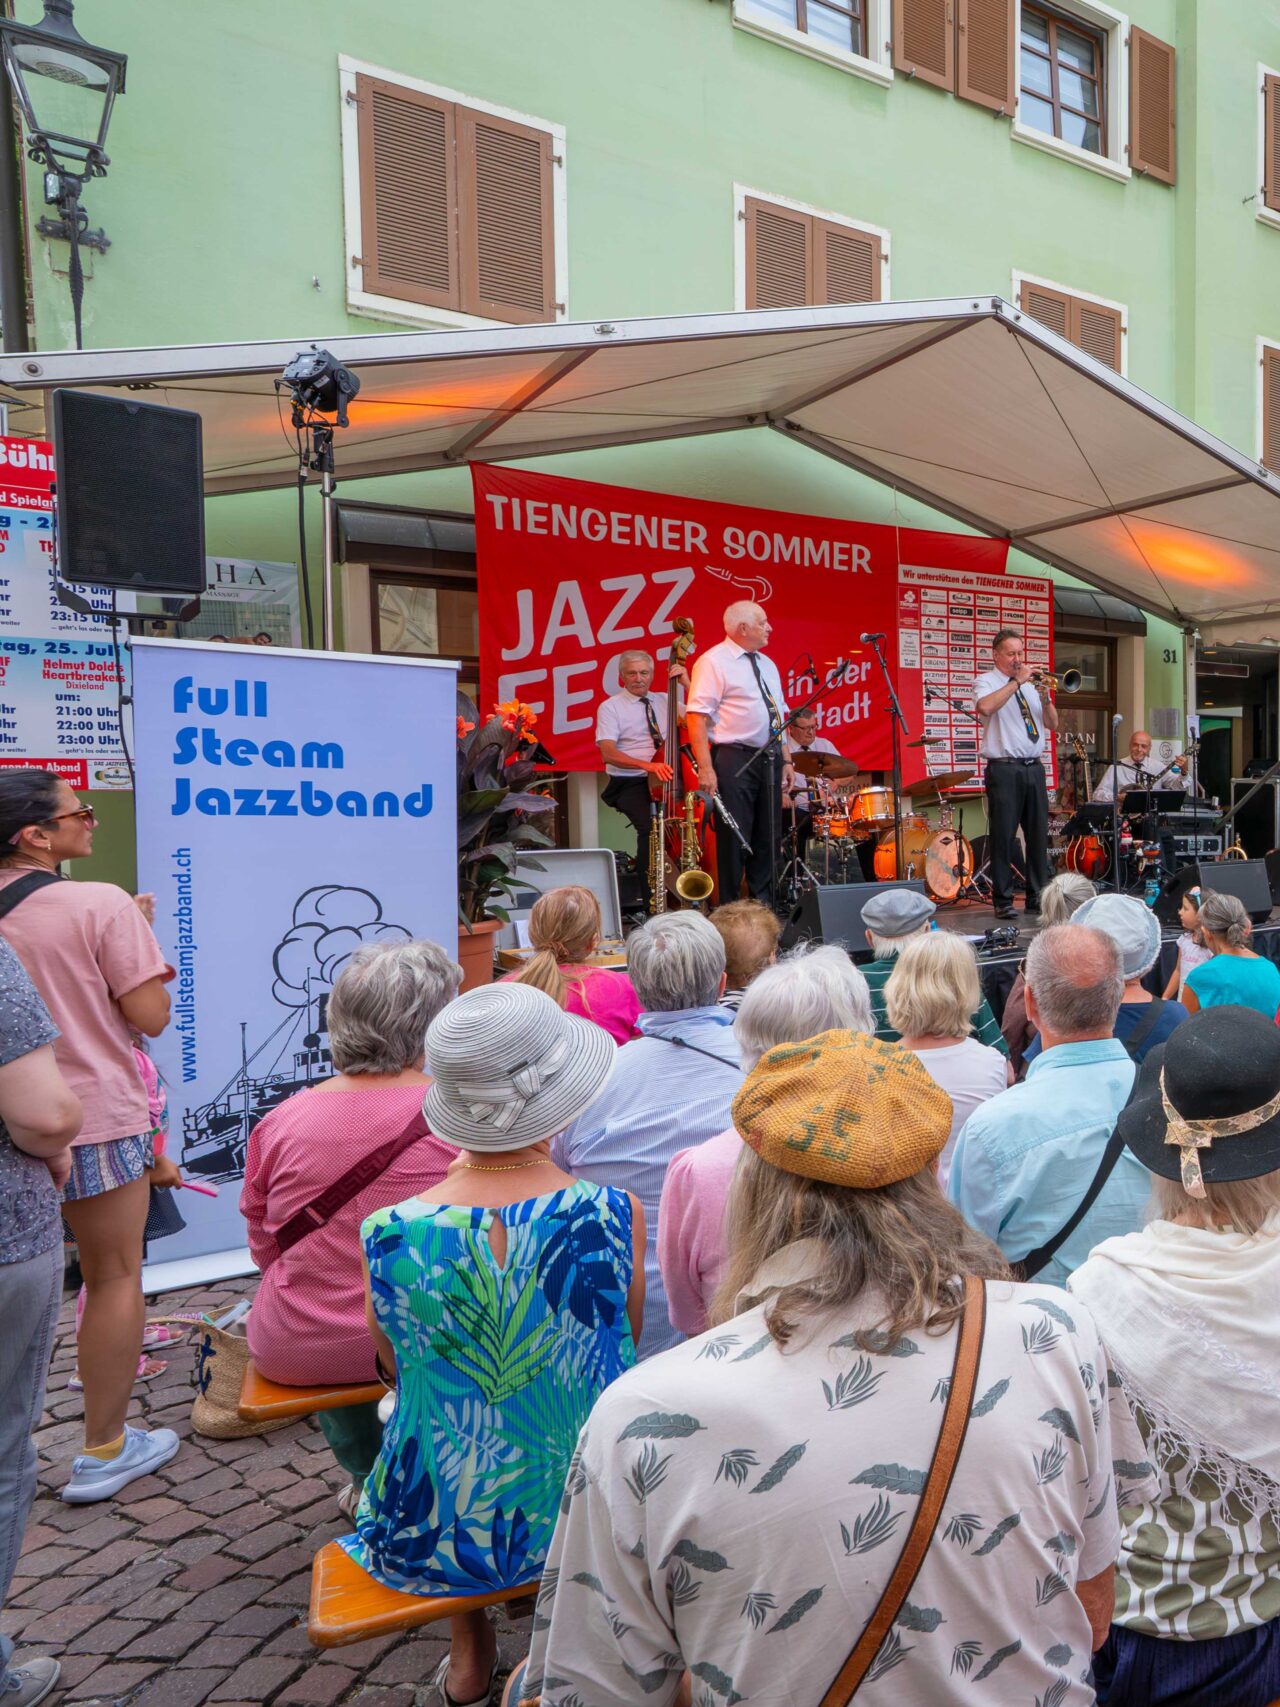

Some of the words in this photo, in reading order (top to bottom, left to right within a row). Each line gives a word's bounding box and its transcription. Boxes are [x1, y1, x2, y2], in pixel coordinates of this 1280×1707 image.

[486, 493, 709, 554] TIENGENER
[723, 526, 873, 574] SOMMER
[903, 569, 915, 580] Wir
[917, 571, 960, 584] unterstützen
[961, 575, 974, 585] den
[975, 577, 1015, 590] TIENGENER
[1015, 581, 1047, 594] SOMMER:
[91, 599, 113, 610] Uhr
[977, 595, 994, 603] hago
[50, 610, 88, 622] 23:15
[501, 565, 696, 662] JAZZ
[45, 641, 78, 655] 25.
[85, 644, 120, 657] Juli
[951, 646, 971, 654] OBI
[1163, 648, 1178, 664] 31
[43, 658, 85, 671] Helmut
[787, 669, 813, 698] in
[825, 656, 872, 689] der
[66, 681, 105, 691] Dixieland
[55, 693, 81, 702] um:
[56, 705, 92, 717] 21:00
[97, 706, 119, 717] Uhr
[56, 720, 93, 731] 22:00
[98, 721, 119, 732] Uhr
[57, 734, 94, 745] 23:00
[98, 735, 120, 746] Uhr
[173, 726, 344, 769] Steam
[46, 761, 81, 773] Abend
[171, 778, 433, 818] Jazzband
[171, 846, 198, 1084] www.fullsteamjazzband.ch
